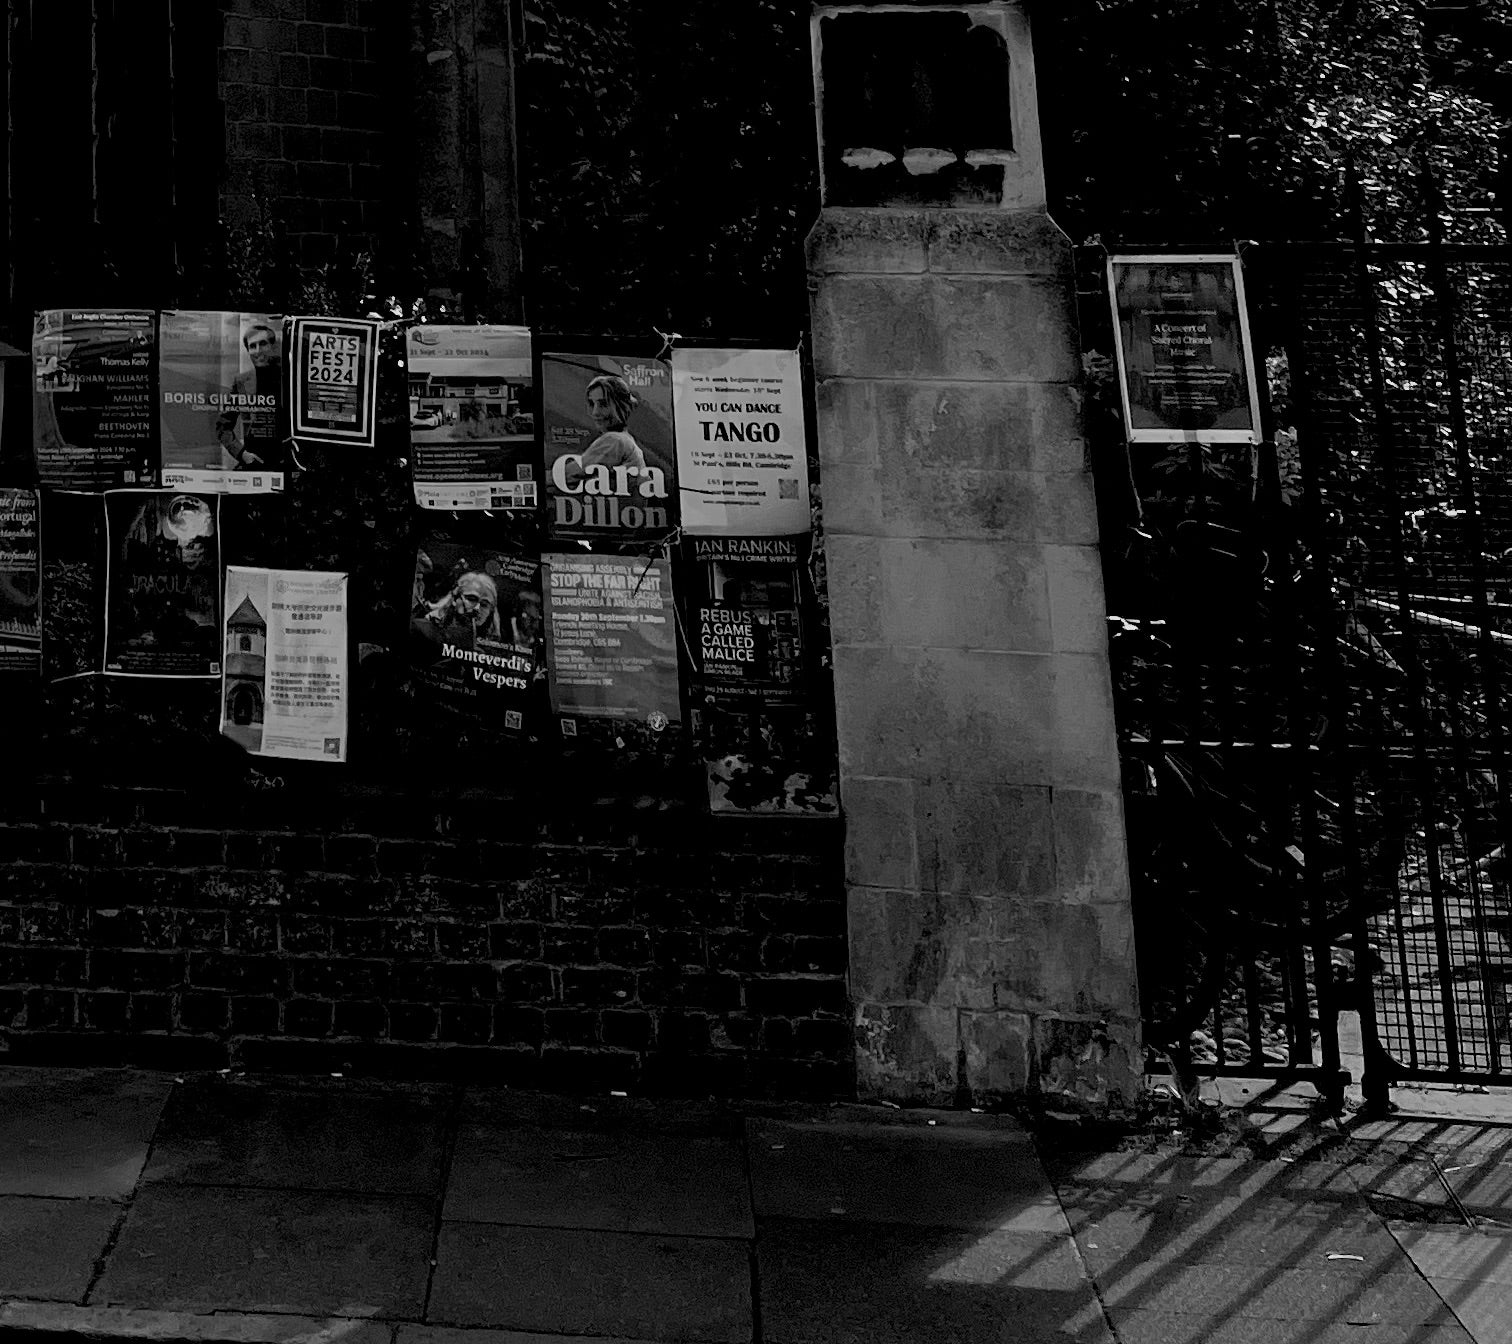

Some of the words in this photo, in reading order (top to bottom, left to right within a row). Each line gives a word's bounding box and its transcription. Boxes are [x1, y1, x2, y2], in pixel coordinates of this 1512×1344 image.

[312, 335, 357, 351] ARTS
[310, 351, 356, 367] FEST
[310, 367, 353, 383] 2024
[623, 364, 664, 377] Saffron
[628, 376, 651, 387] Hall
[164, 392, 205, 404] BORIS
[209, 393, 276, 406] GILTBURG
[695, 402, 717, 412] YOU
[720, 402, 742, 413] CAN
[745, 403, 782, 414] DANCE
[98, 422, 149, 431] BEETHOVEN
[698, 421, 781, 443] TANGO
[552, 454, 669, 499] Cara
[13, 494, 36, 511] from
[553, 495, 669, 529] Dillon
[695, 540, 723, 554] IAN
[551, 573, 580, 587] STOP
[581, 574, 604, 589] THE
[604, 574, 626, 589] FAR
[627, 575, 660, 591] RIGHT
[700, 608, 752, 624] REBUS
[701, 623, 711, 634] A
[713, 623, 752, 637] GAME
[701, 634, 755, 648] CALLED
[441, 643, 532, 673] Monteverdi's
[702, 647, 755, 662] MALICE
[473, 667, 527, 690] Vespers
